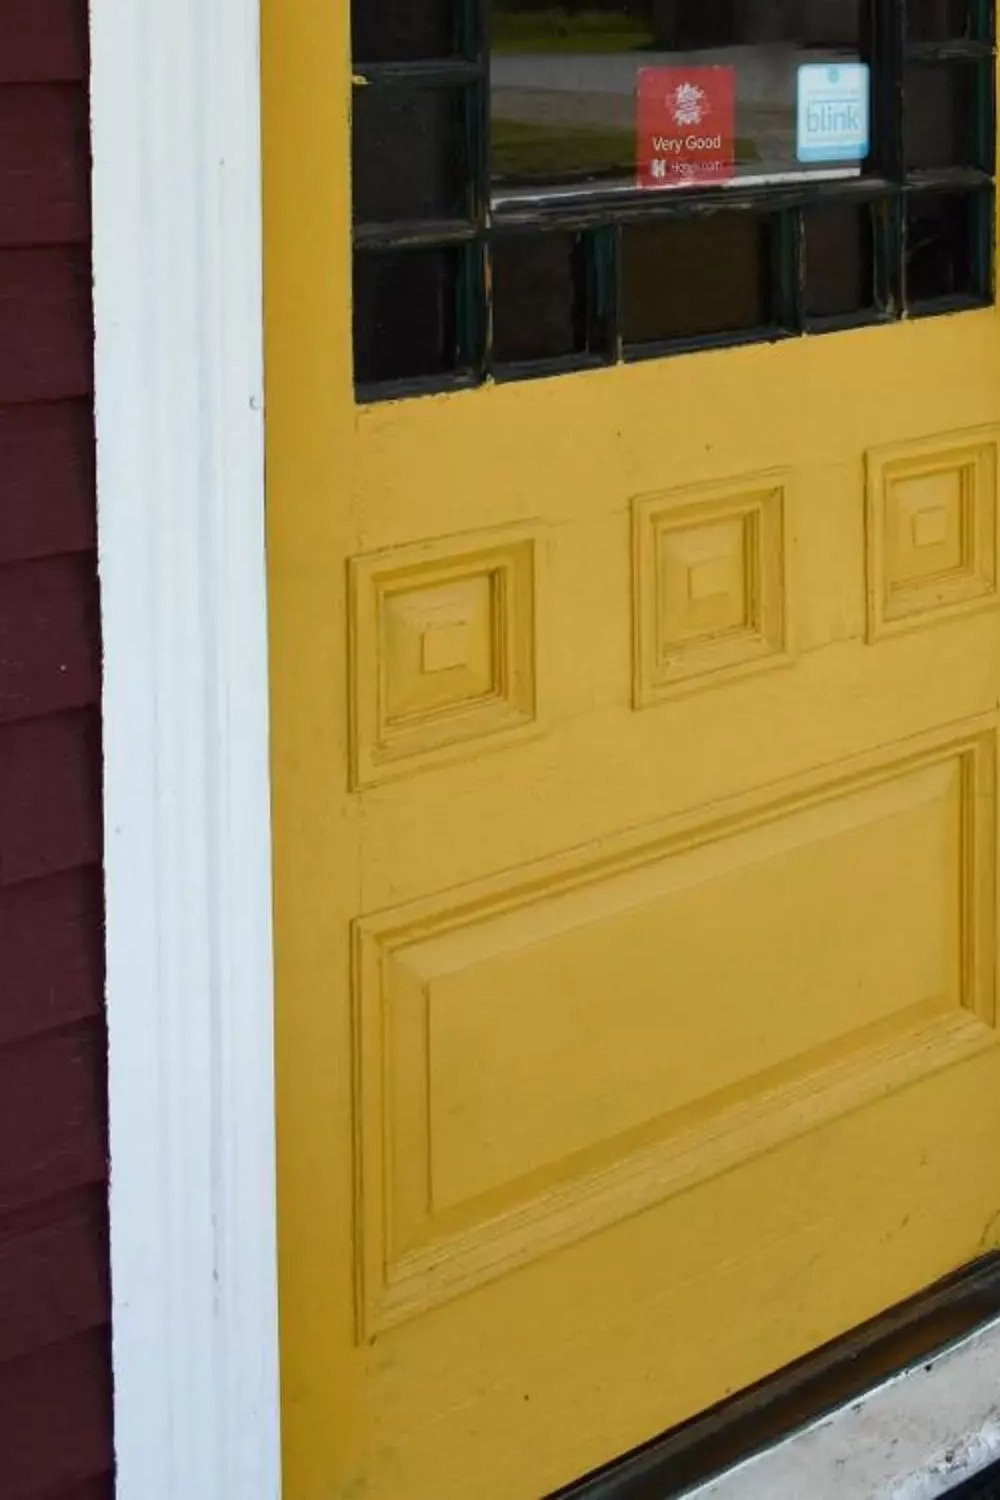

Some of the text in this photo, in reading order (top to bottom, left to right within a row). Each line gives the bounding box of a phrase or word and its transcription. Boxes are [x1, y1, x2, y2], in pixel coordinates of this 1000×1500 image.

[807, 101, 860, 132] blink
[651, 134, 721, 155] Very Good
